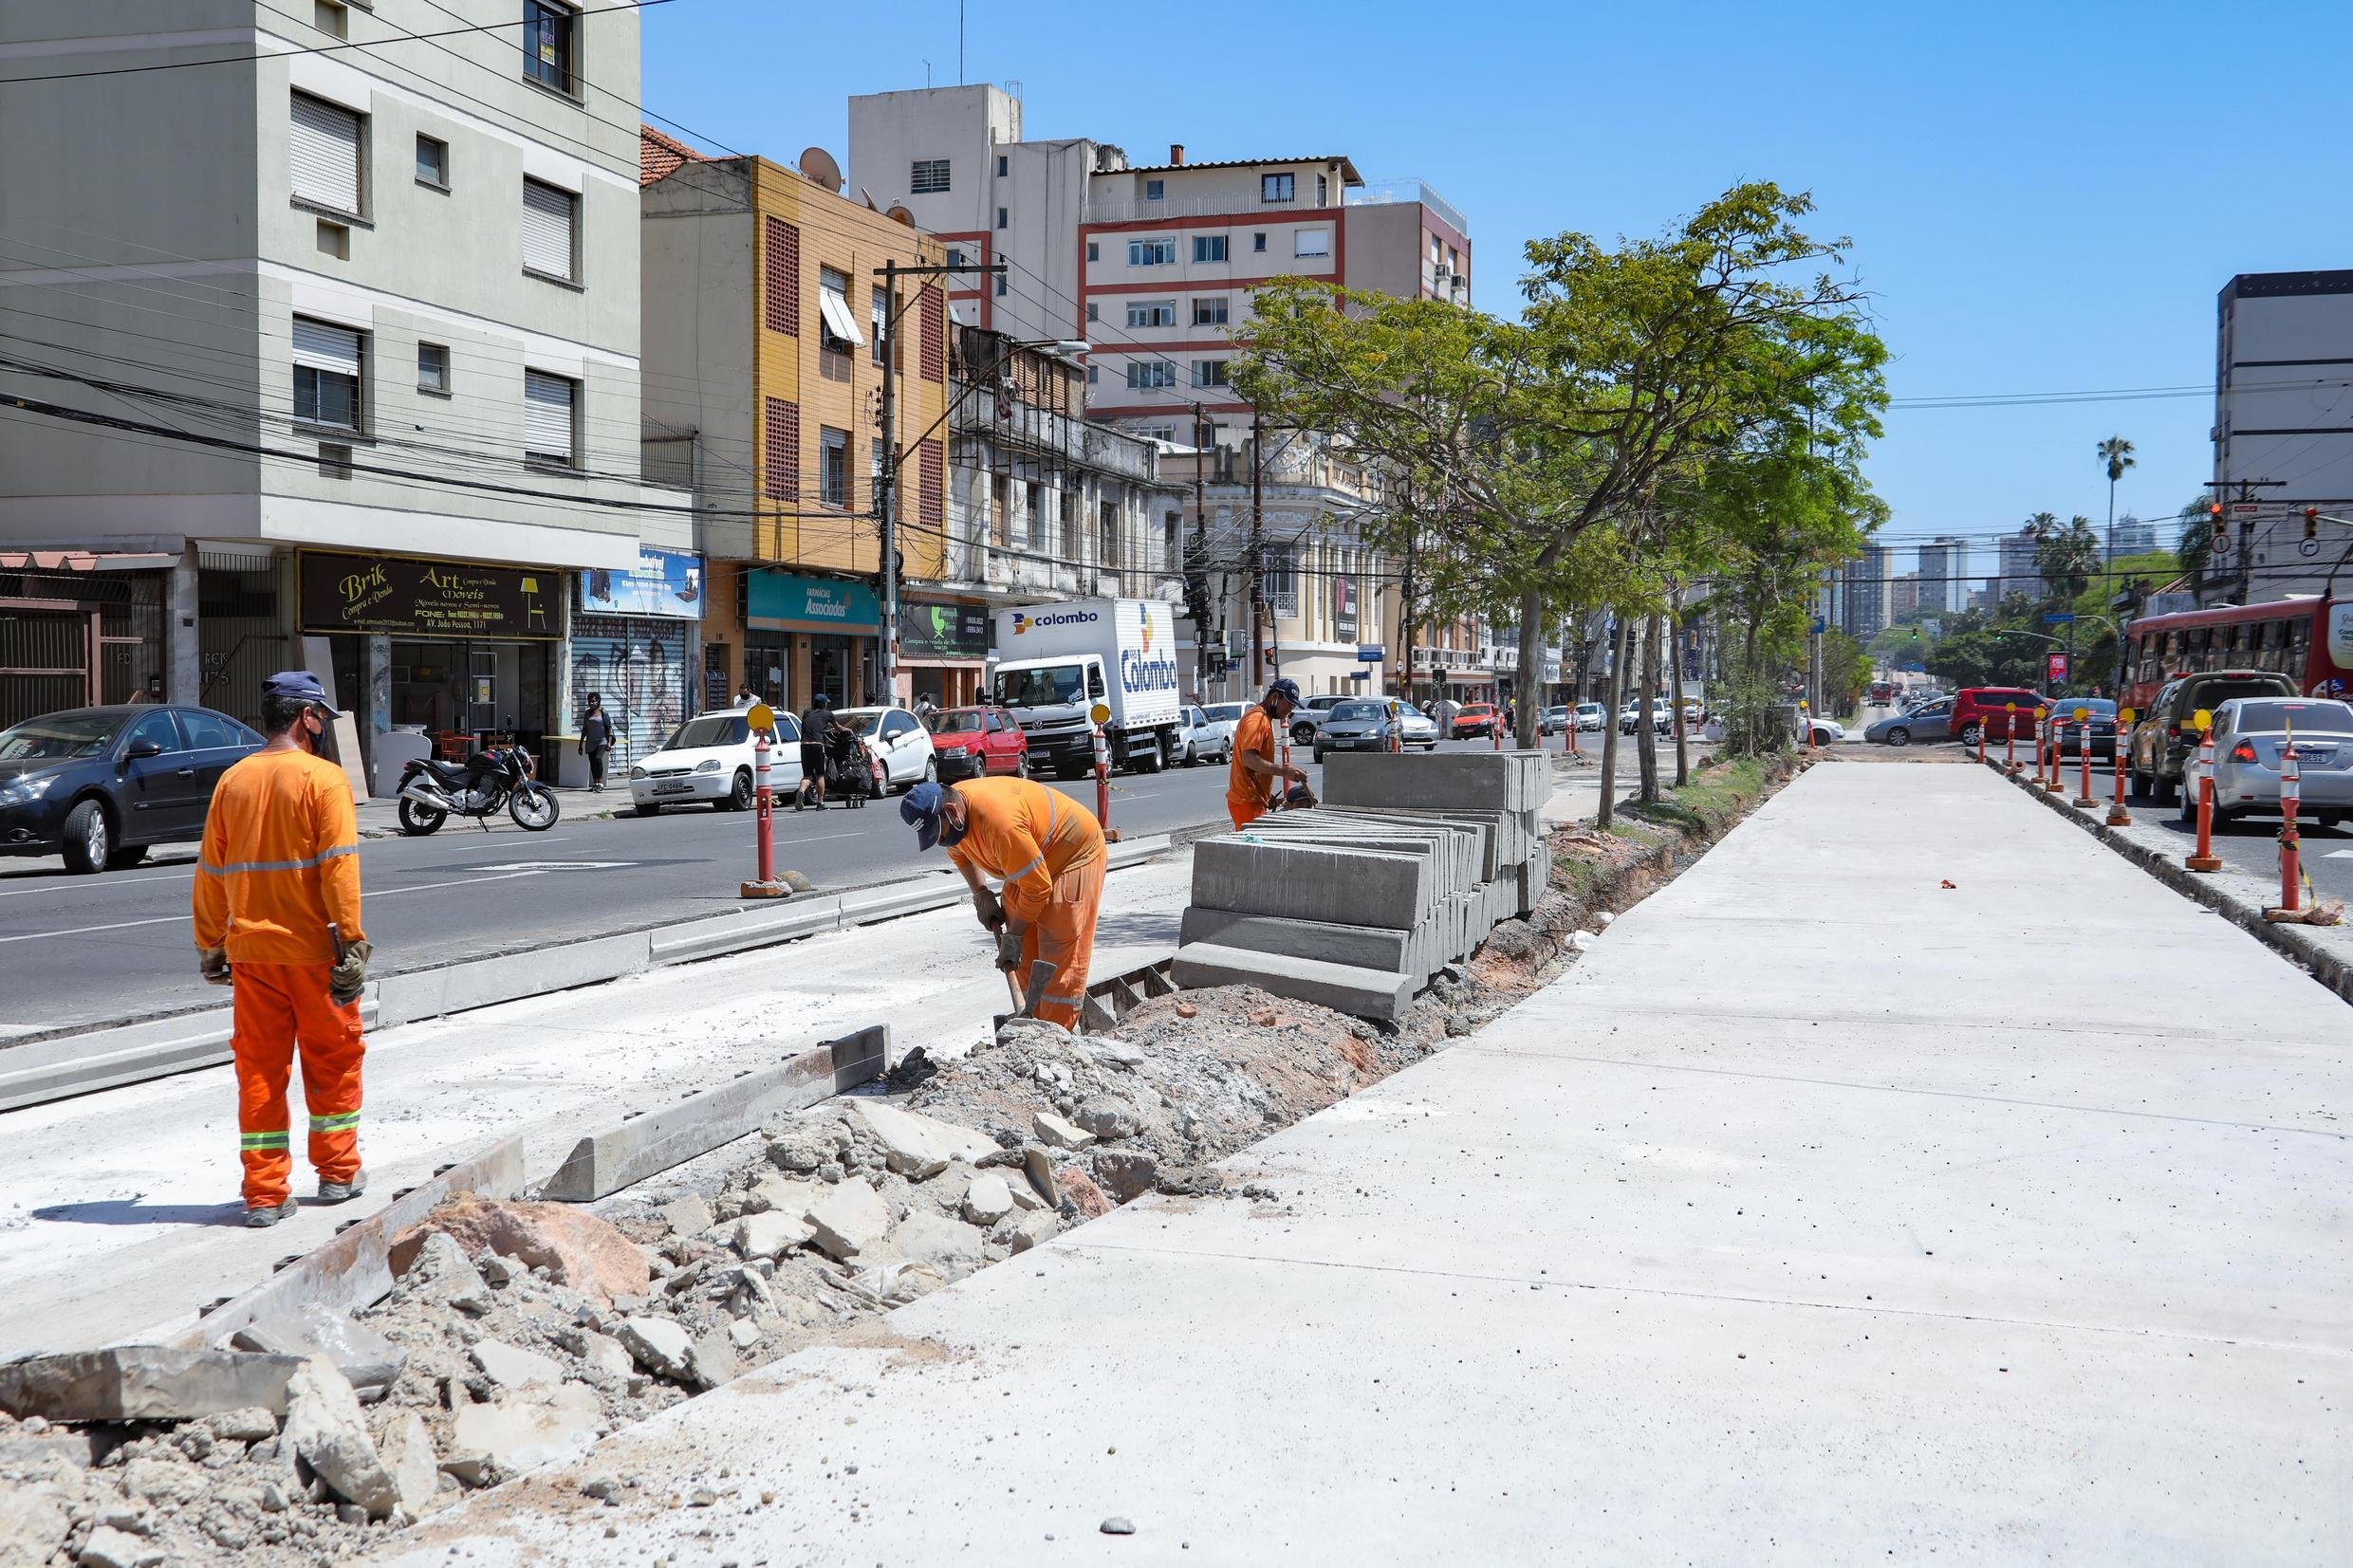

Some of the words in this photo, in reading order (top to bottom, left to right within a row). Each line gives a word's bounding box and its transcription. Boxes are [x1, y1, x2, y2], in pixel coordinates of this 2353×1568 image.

[340, 563, 387, 602] Brik
[806, 598, 845, 617] Associadas
[437, 619, 452, 628] João
[473, 620, 487, 629] 1171
[1035, 611, 1098, 626] colombo
[1121, 648, 1177, 692] Colombo
